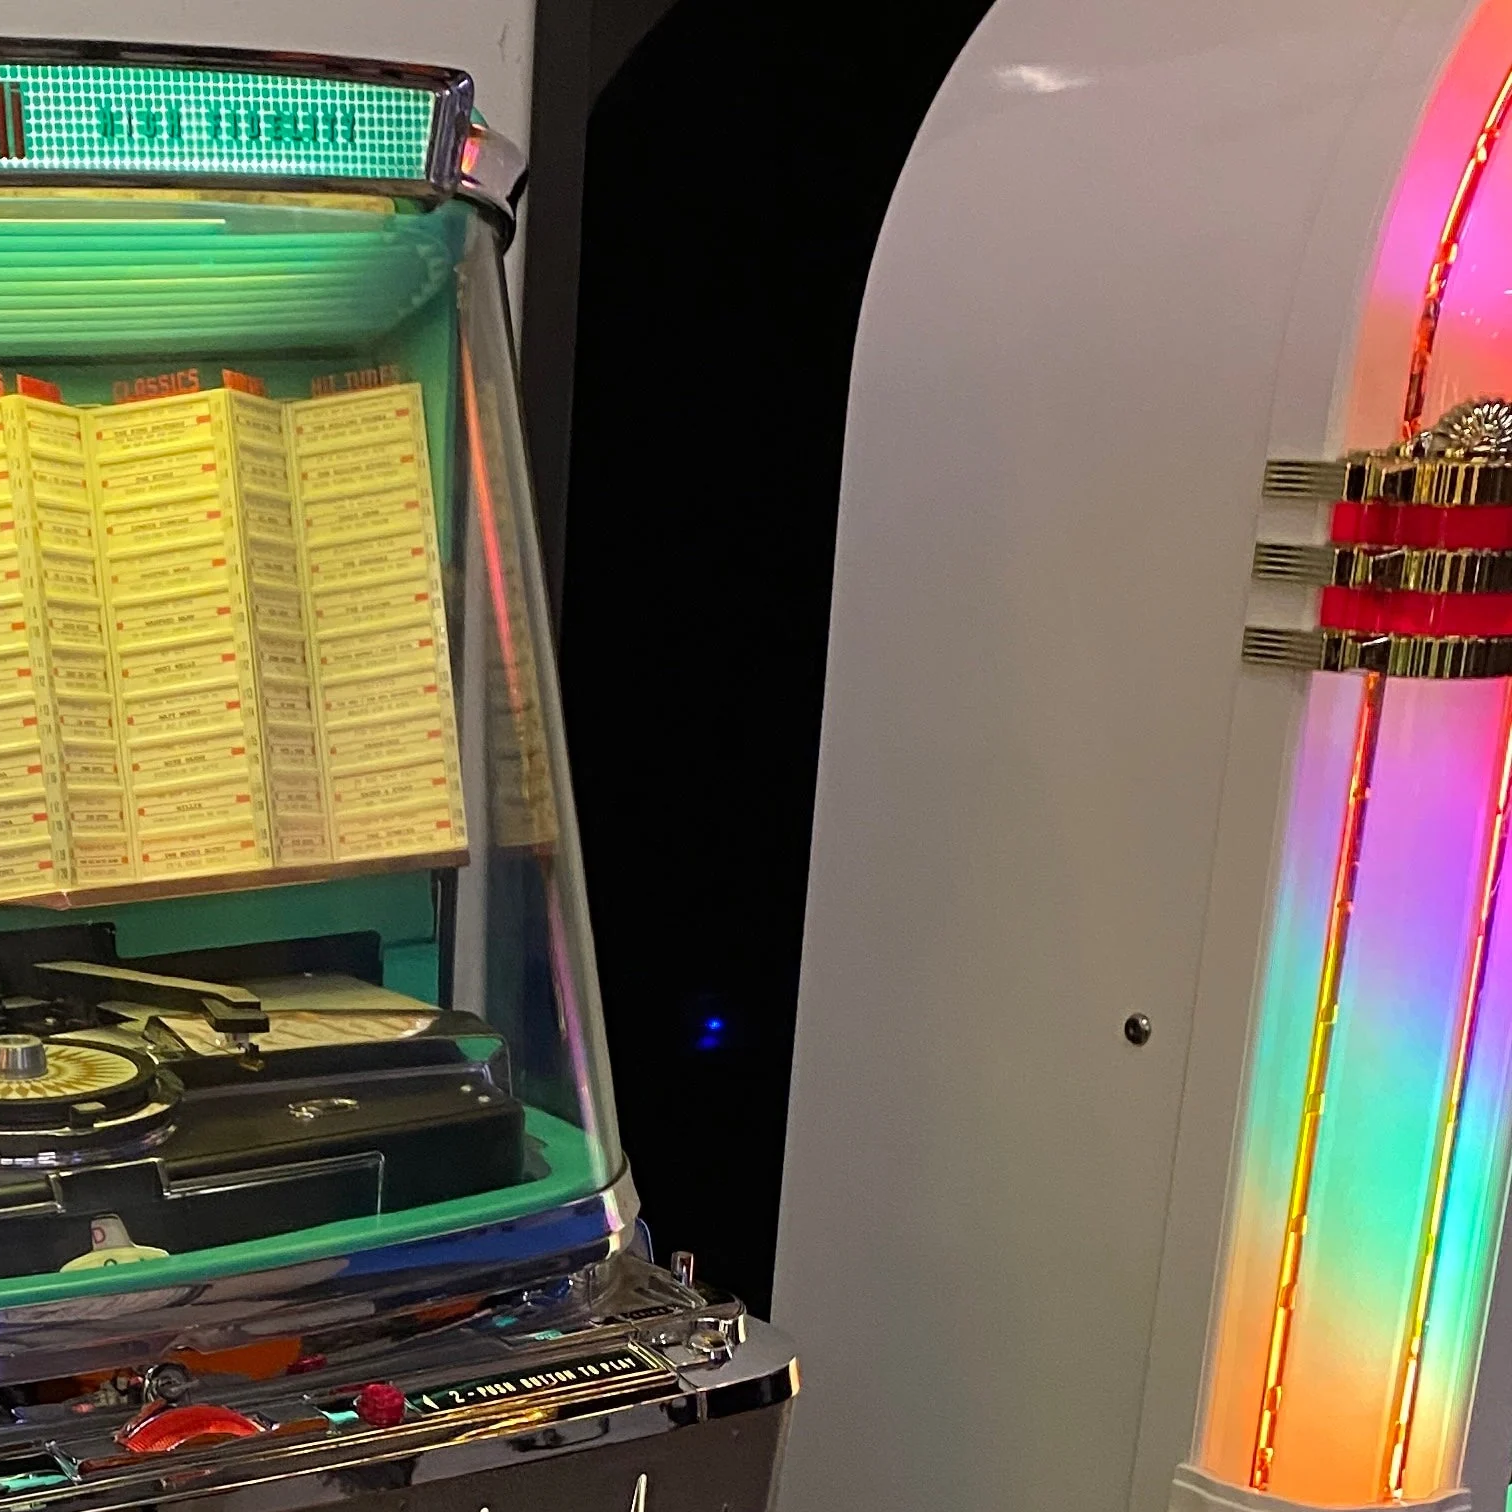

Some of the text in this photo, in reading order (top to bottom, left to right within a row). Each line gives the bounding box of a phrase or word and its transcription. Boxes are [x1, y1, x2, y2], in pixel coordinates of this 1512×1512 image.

[448, 1390, 465, 1404] 2
[477, 1381, 516, 1397] PUSH
[519, 1369, 576, 1389] BUTTON
[577, 1364, 600, 1377] TO
[599, 1357, 637, 1373] PLAY
